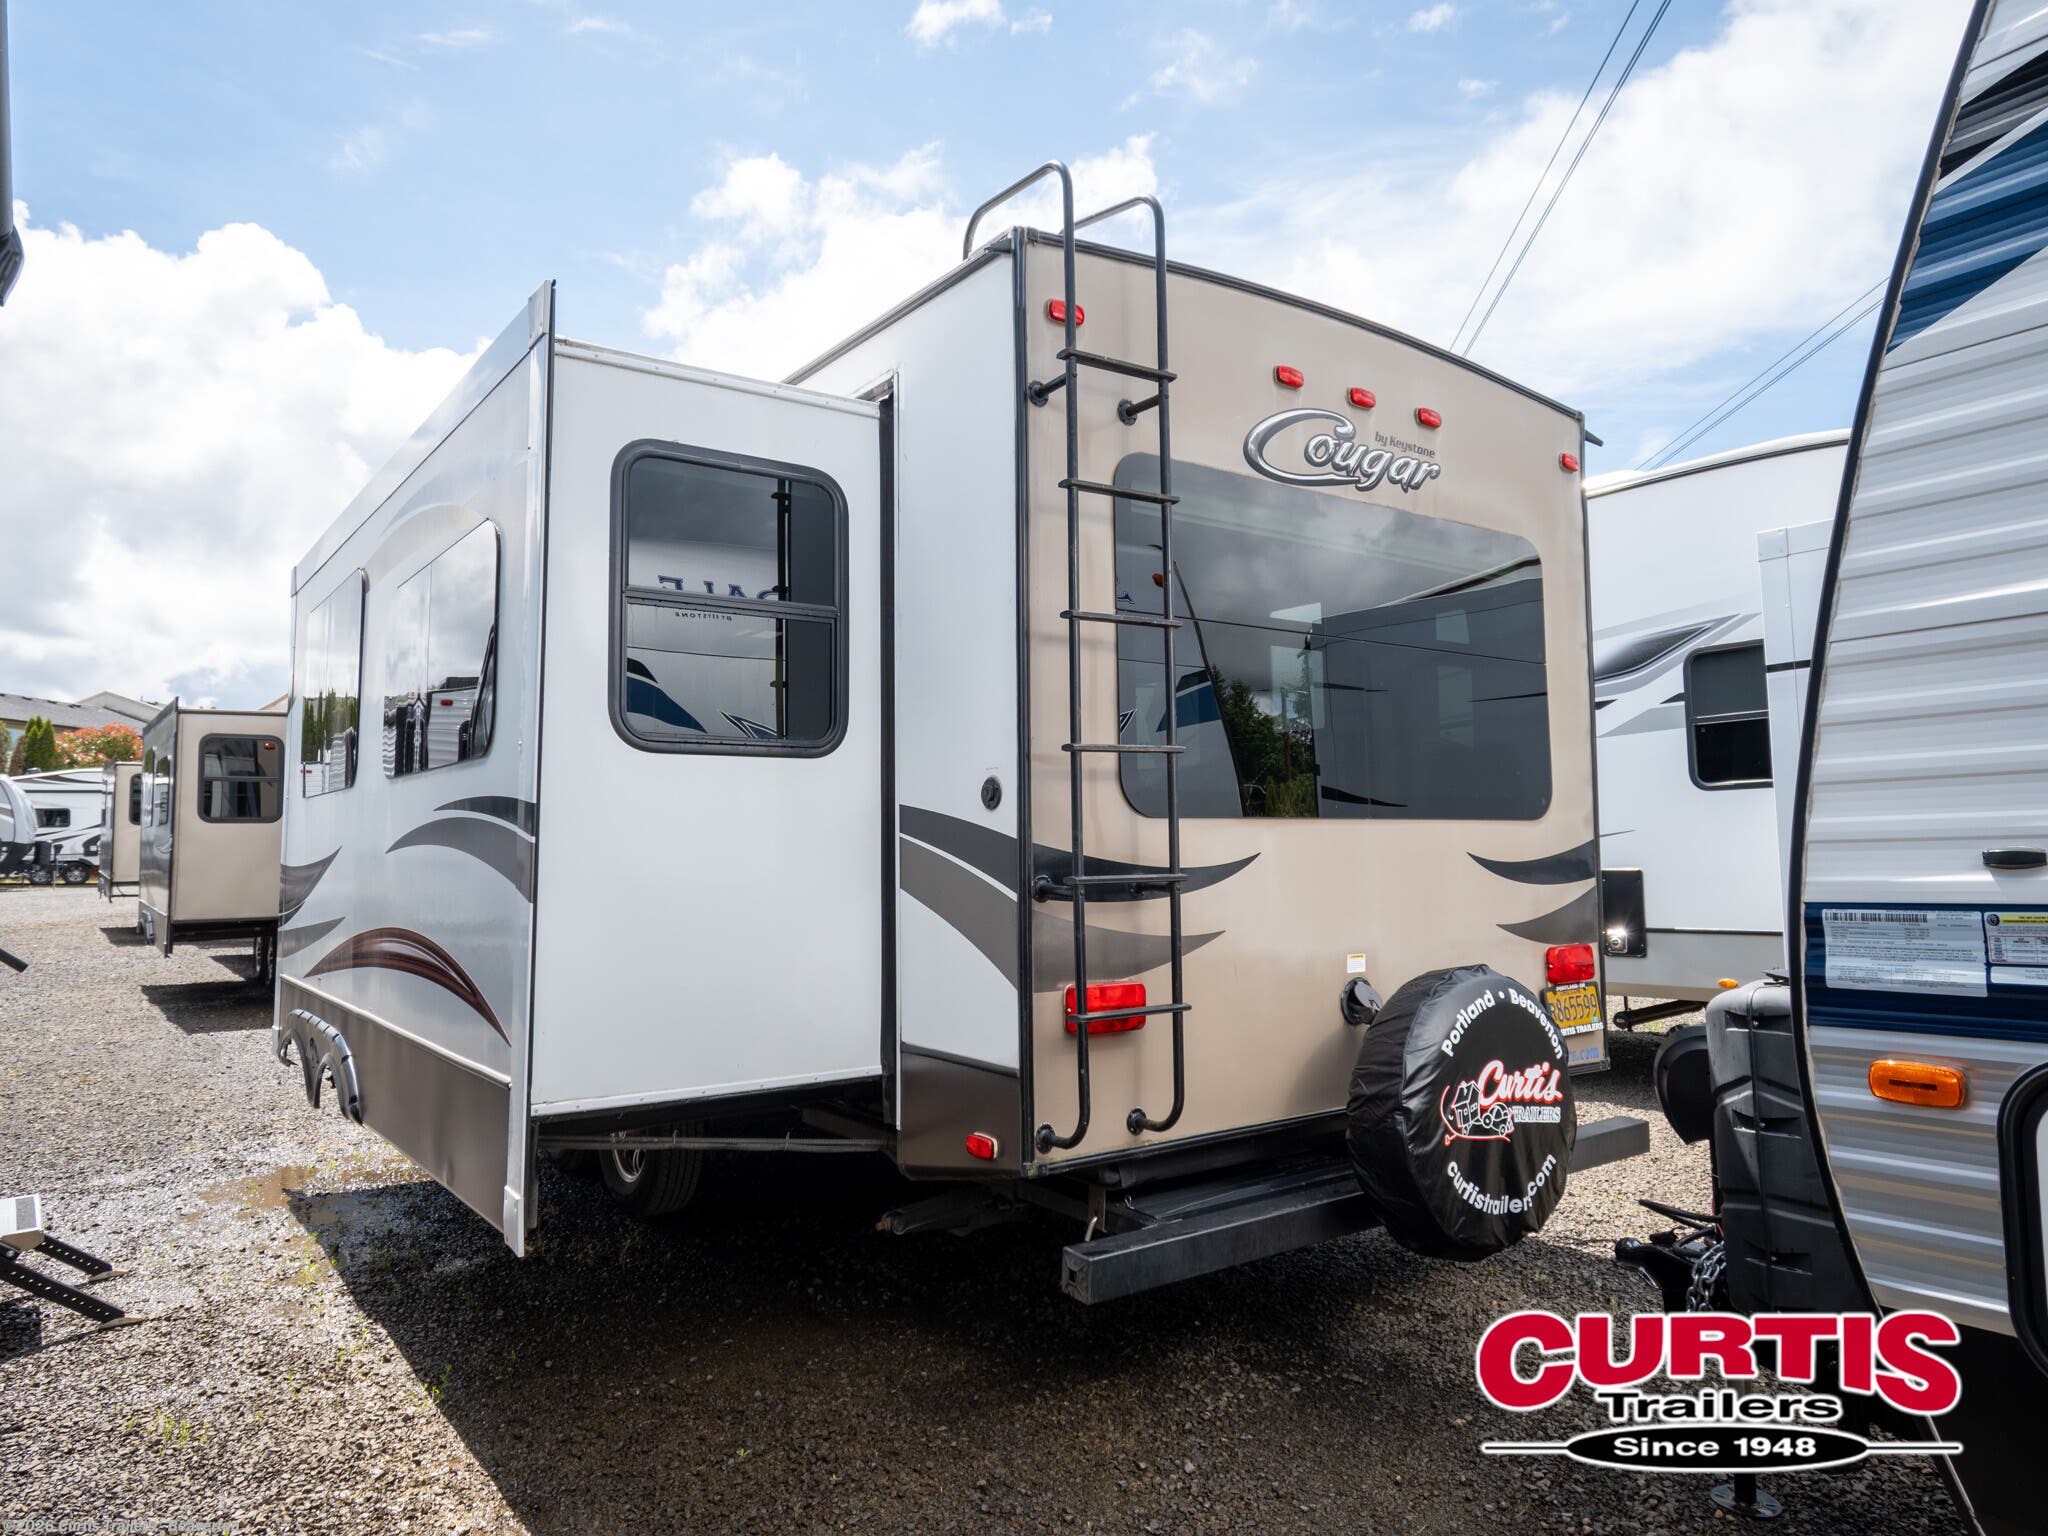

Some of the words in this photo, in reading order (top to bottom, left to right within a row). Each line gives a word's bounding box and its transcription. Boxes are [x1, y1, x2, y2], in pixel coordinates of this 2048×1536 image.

[1243, 407, 1441, 493] Cougar
[1374, 431, 1388, 447] by
[1389, 436, 1436, 459] Keystone
[1441, 989, 1496, 1058] Portland
[1576, 1022, 1604, 1034] TRAILERS
[1478, 1060, 1563, 1108] Curtis
[1511, 1106, 1561, 1123] TRAILERS
